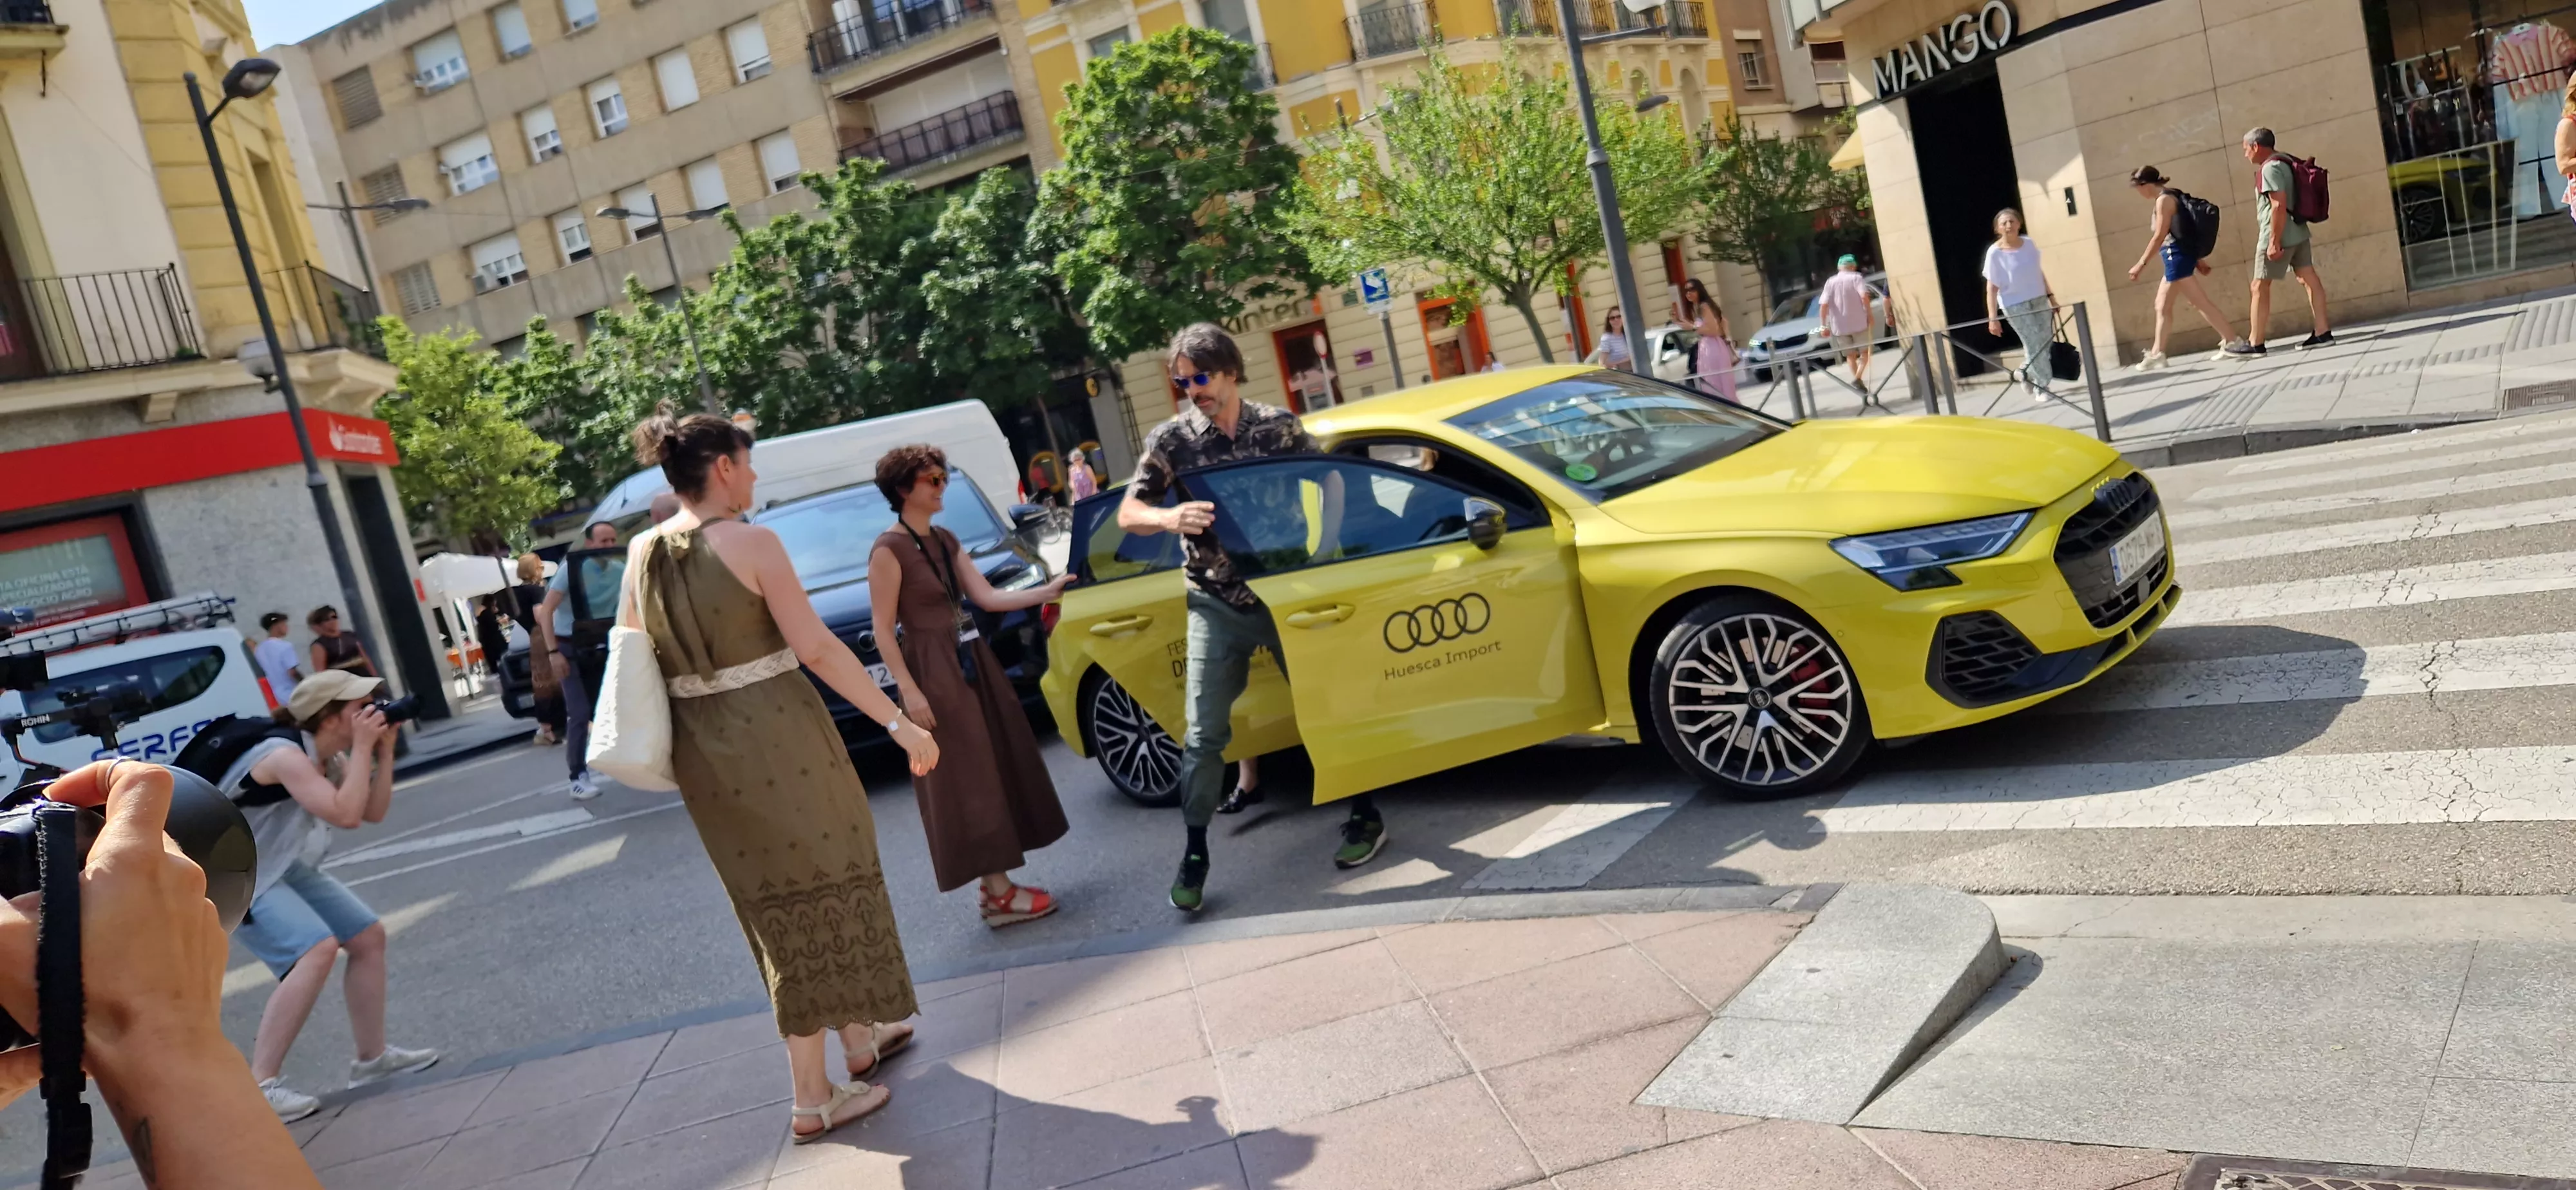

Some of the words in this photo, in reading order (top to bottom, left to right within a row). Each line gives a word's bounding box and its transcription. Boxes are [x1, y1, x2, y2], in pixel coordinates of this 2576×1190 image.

[1871, 0, 2011, 100] MANGO
[1385, 658, 1441, 681] Huesca
[1445, 641, 1502, 665] Import
[21, 714, 50, 728] RONIN
